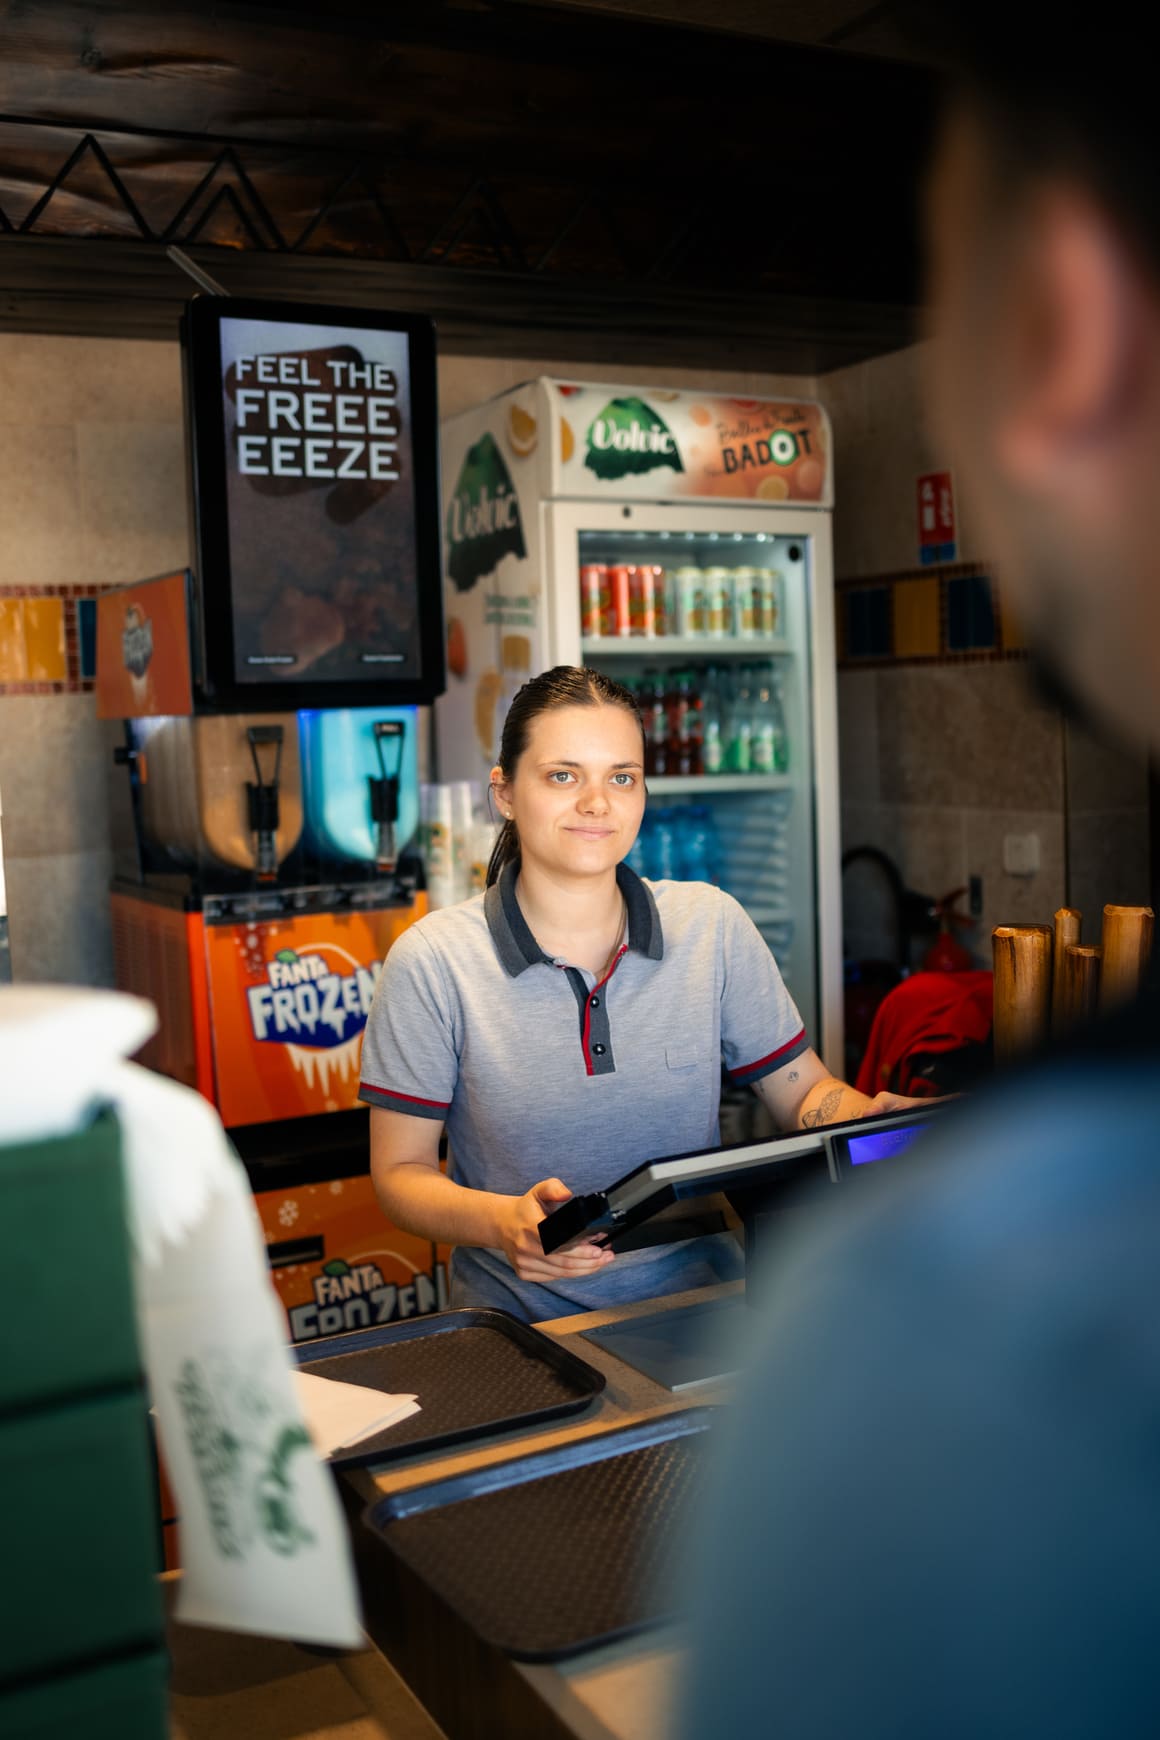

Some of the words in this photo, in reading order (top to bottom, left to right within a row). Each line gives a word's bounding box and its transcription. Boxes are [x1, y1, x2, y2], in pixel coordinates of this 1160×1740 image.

[235, 355, 320, 387] FEEL
[327, 360, 395, 391] THE
[236, 388, 397, 436] FREEE
[591, 418, 677, 455] Volvic
[238, 436, 399, 480] EEEZE
[268, 953, 330, 989] FANTA
[247, 961, 384, 1040] FROZEN
[313, 1264, 385, 1305] FANTA
